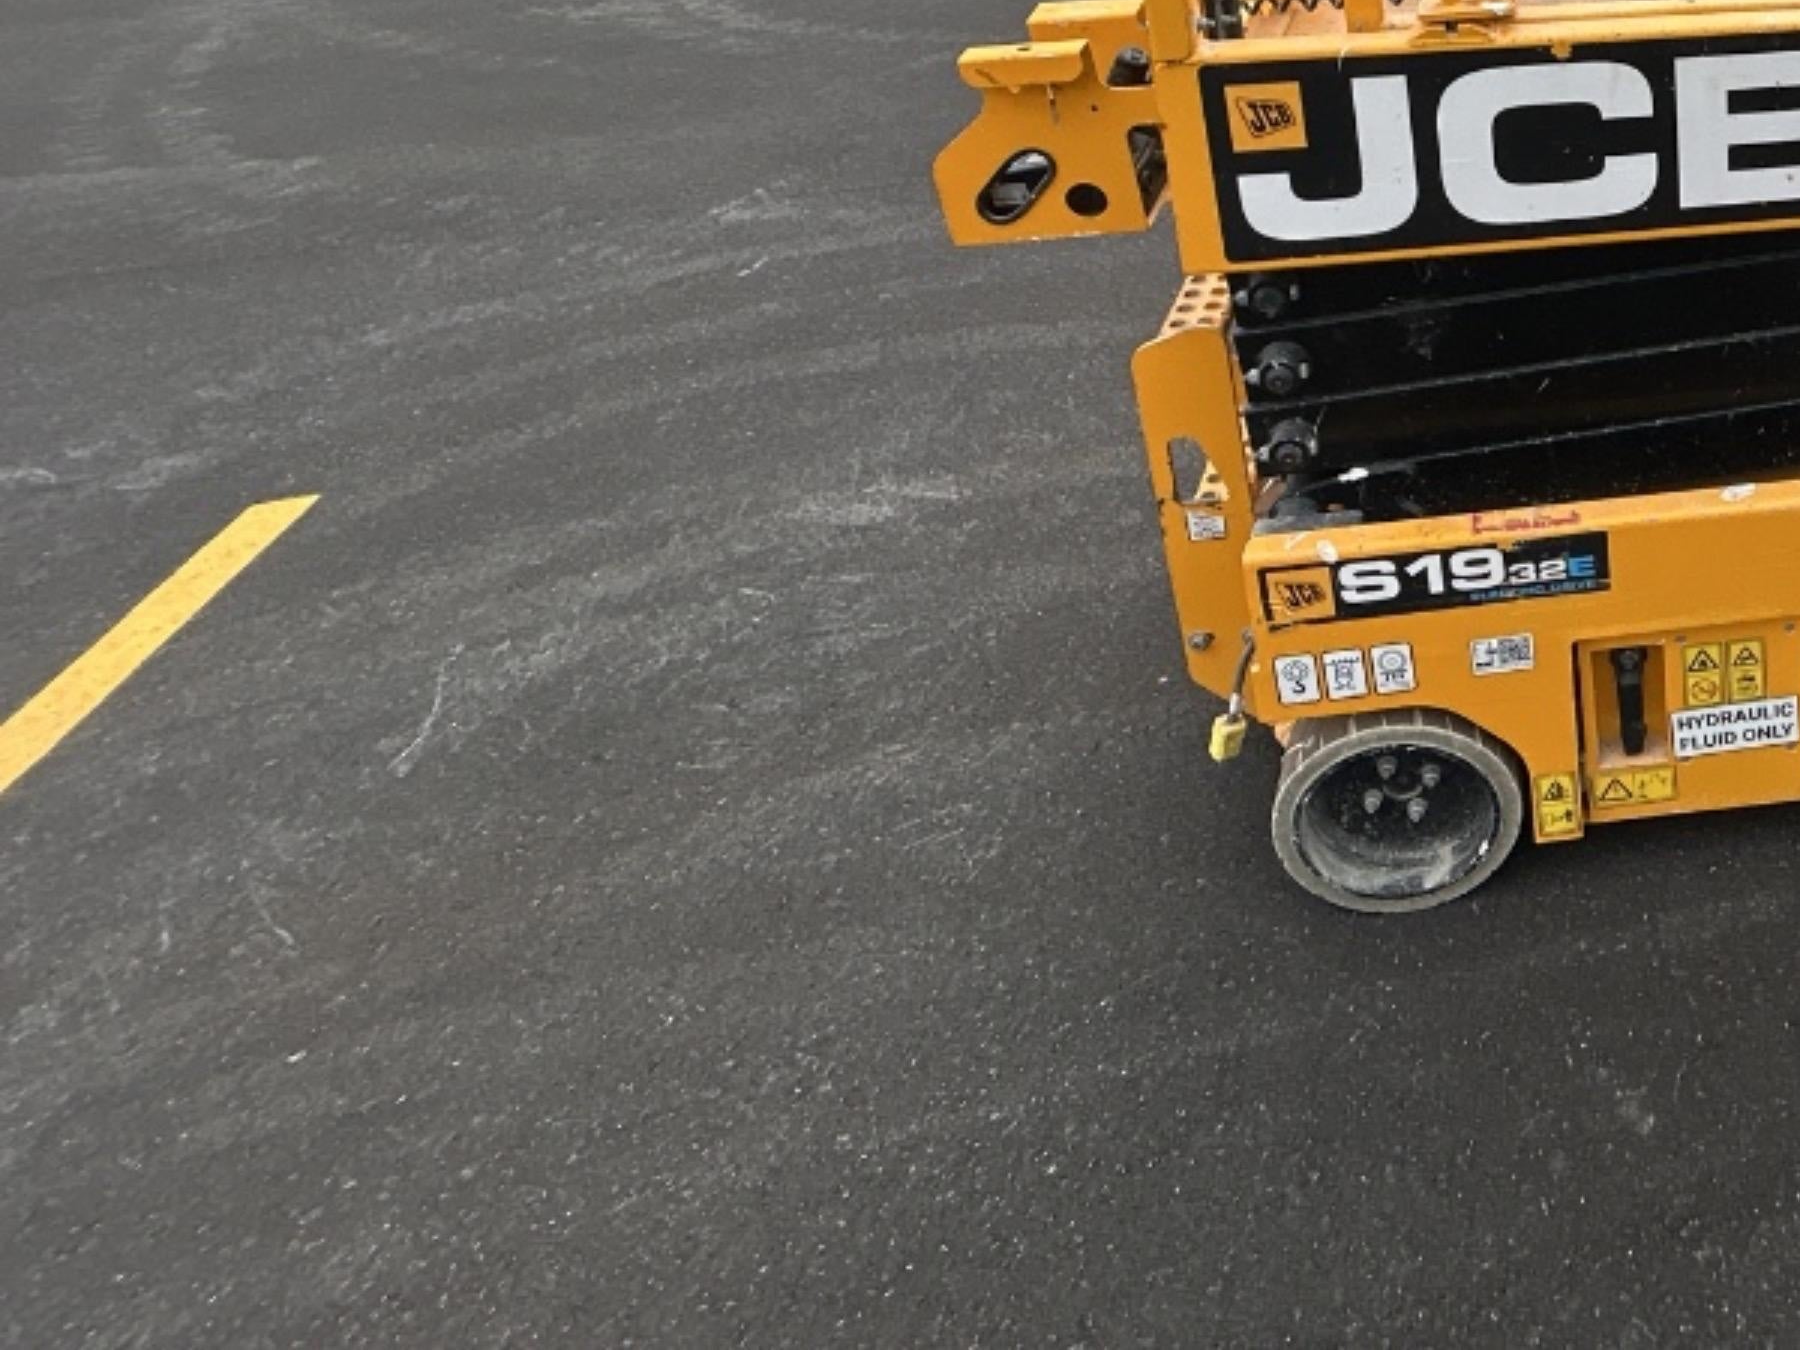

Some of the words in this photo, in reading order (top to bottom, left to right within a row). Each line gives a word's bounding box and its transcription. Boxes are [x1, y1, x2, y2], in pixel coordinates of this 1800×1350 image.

[1243, 99, 1294, 136] JCB
[1676, 701, 1794, 731] HYDRAULIC
[1679, 731, 1738, 751] FLUID
[1742, 723, 1794, 742] ONLY
